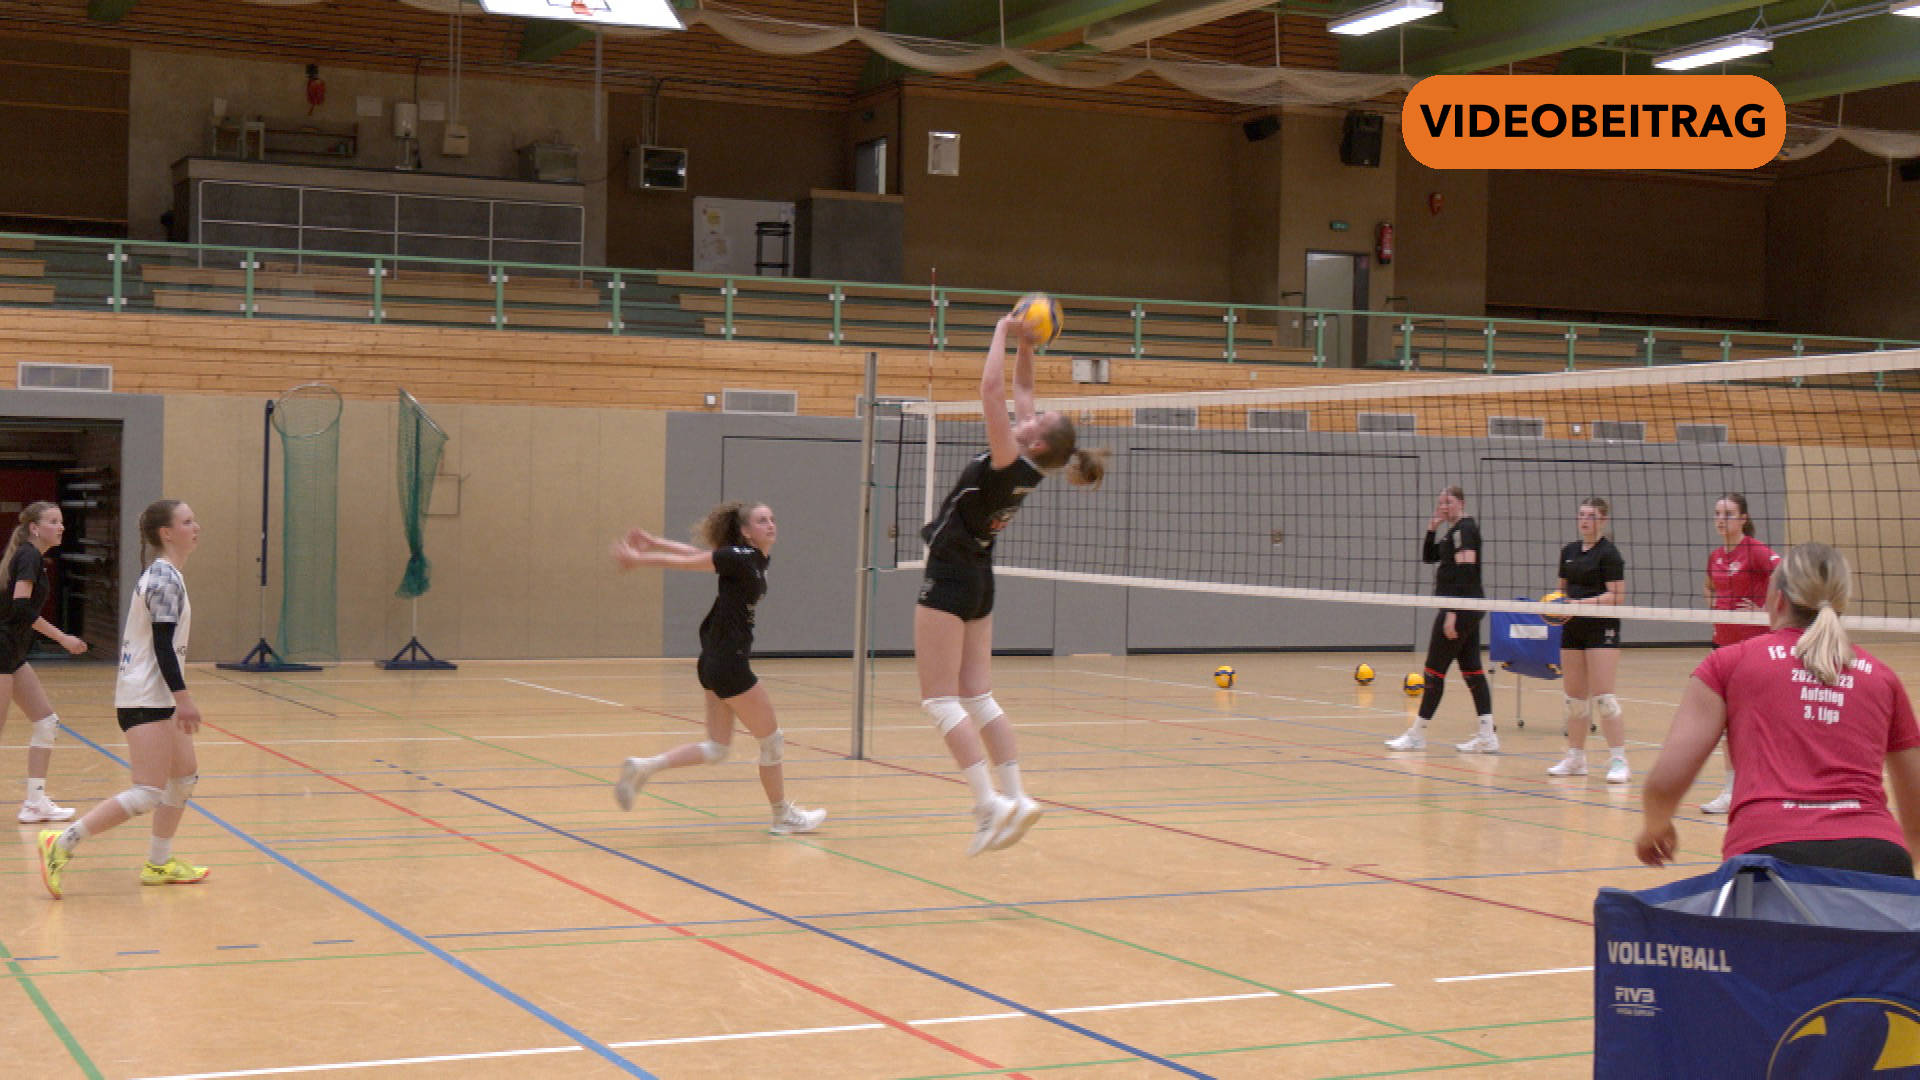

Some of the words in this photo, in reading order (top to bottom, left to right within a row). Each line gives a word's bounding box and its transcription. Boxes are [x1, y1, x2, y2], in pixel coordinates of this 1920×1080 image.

[1768, 645, 1787, 660] FC
[1800, 686, 1845, 707] Aufstieg
[1803, 705, 1815, 720] 3.
[1817, 707, 1840, 724] Liga
[1607, 940, 1732, 973] VOLLEYBALL
[1615, 985, 1656, 1003] FIVB
